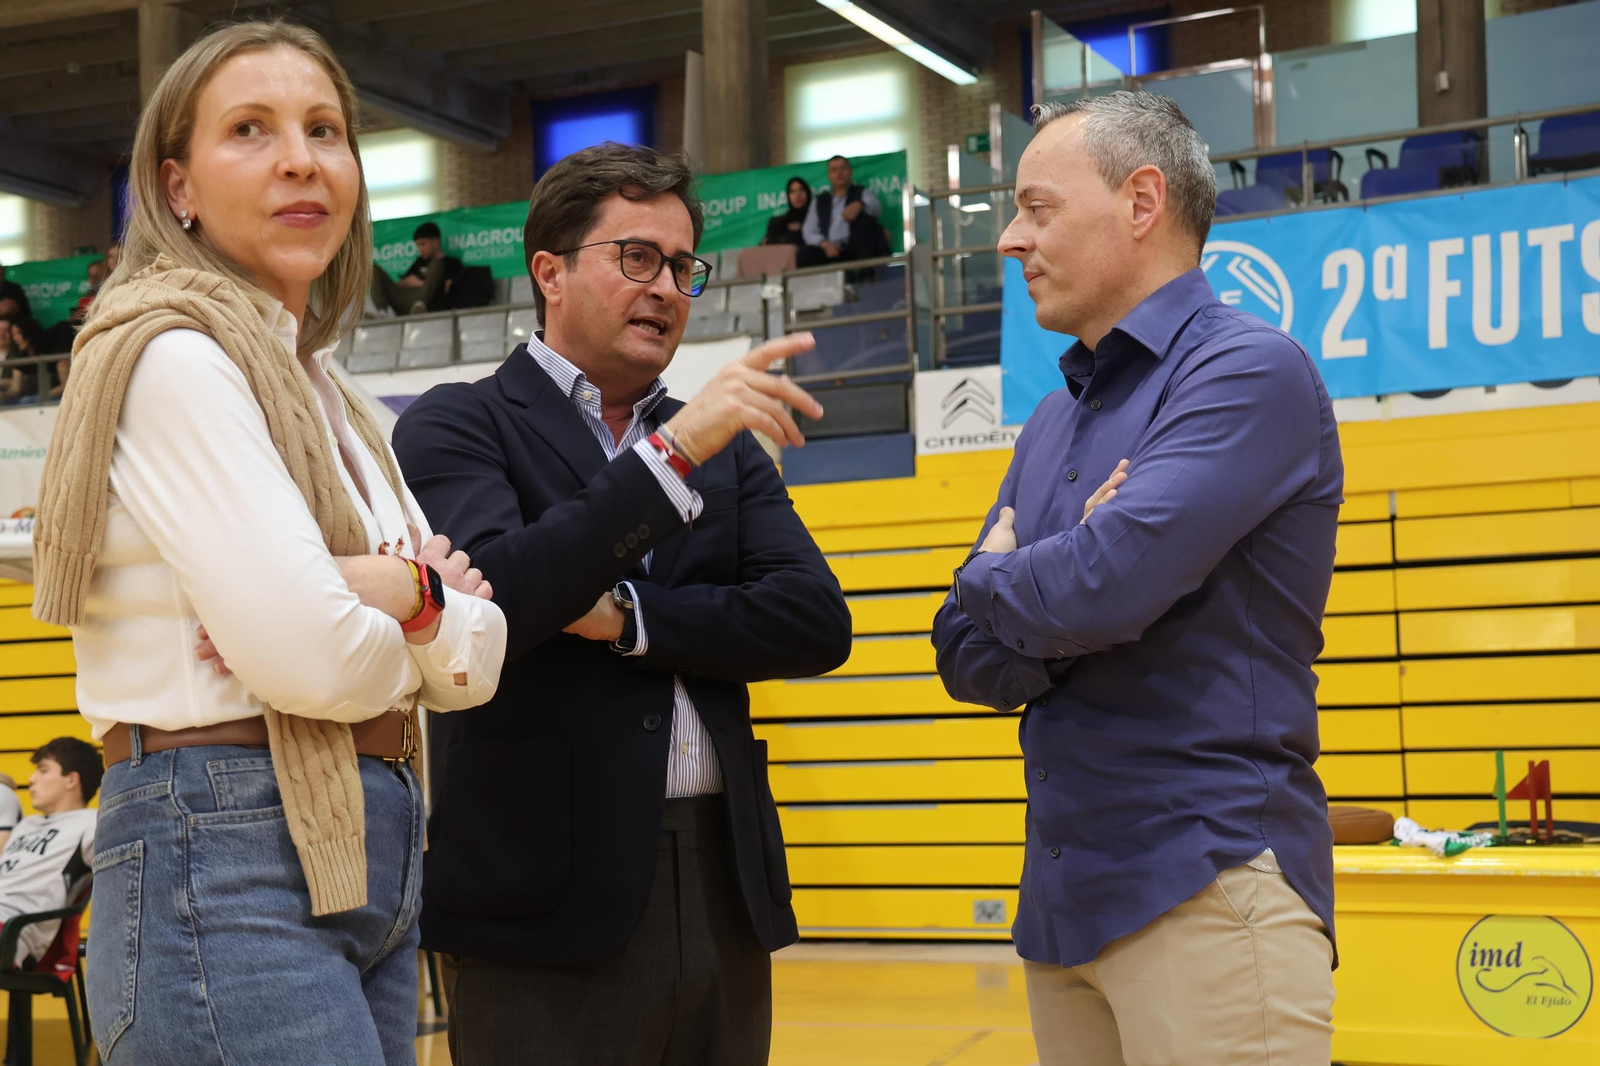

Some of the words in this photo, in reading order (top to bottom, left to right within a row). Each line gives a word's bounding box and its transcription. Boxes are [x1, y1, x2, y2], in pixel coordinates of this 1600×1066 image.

[448, 227, 525, 251] INAGROU
[1469, 941, 1522, 968] imd
[1526, 995, 1538, 1006] El
[1541, 995, 1572, 1008] Ejido
